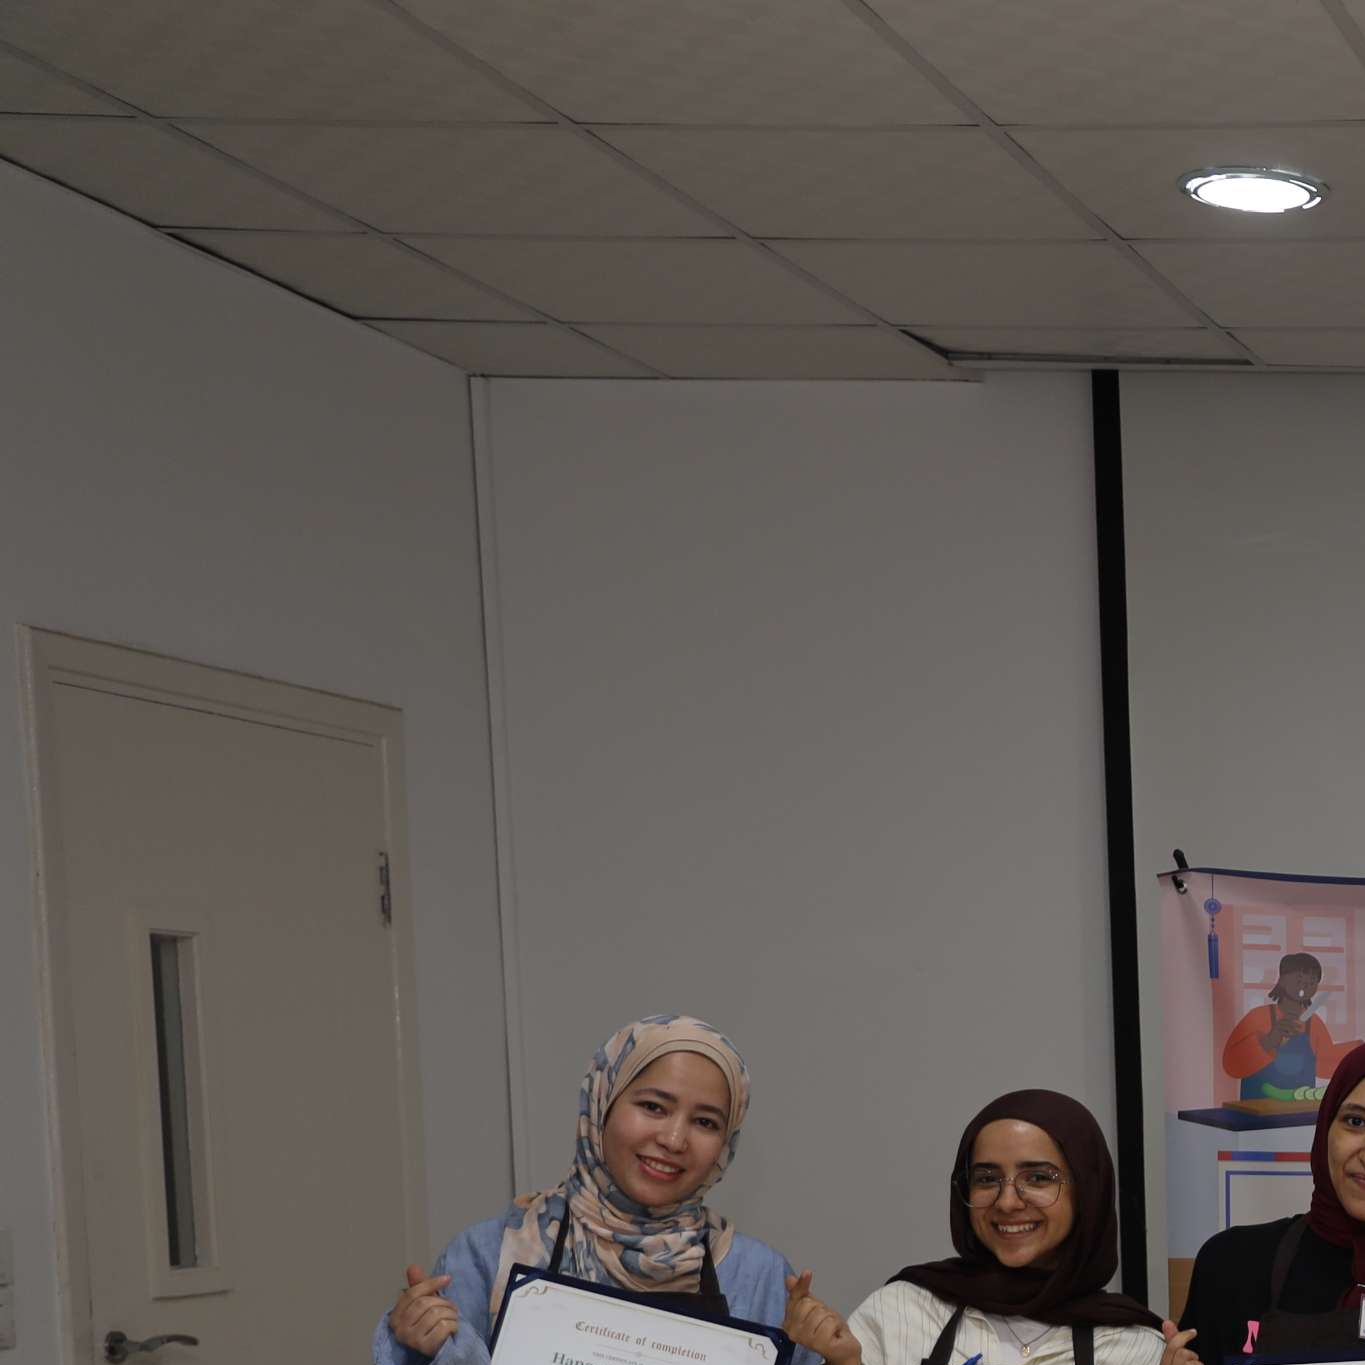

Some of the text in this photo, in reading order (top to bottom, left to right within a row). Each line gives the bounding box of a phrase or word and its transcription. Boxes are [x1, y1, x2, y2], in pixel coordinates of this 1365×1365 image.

[575, 1321, 706, 1361] Certificate of completion
